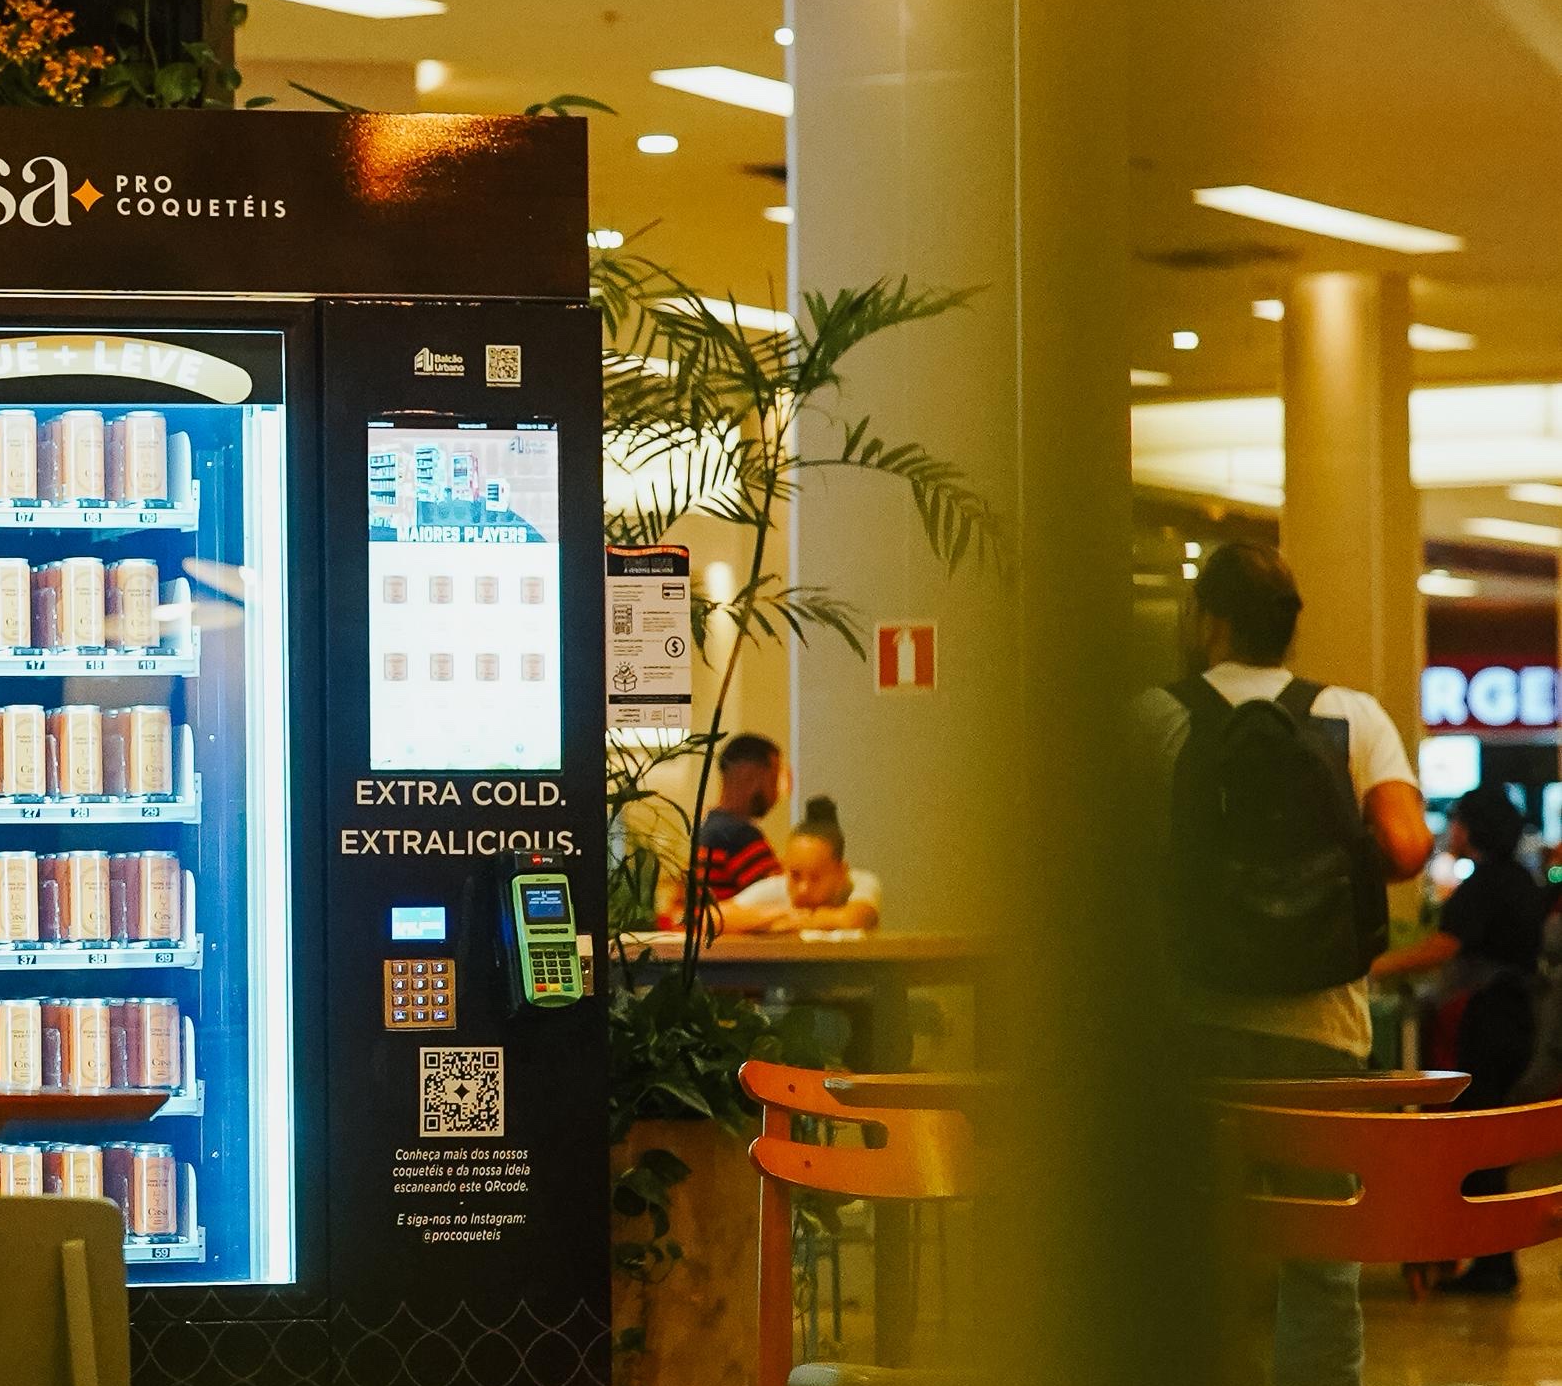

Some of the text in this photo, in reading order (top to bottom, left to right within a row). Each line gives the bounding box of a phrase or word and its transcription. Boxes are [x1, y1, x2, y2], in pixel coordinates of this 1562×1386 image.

[116, 174, 172, 193] PRO
[116, 195, 286, 218] COQUETÉIS
[94, 340, 203, 387] LEVE
[464, 526, 528, 542] PLAYERS
[27, 660, 43, 670] 17
[140, 660, 155, 670] 19
[357, 780, 566, 806] EXTRA COLD.
[24, 809, 39, 819] 27
[144, 808, 158, 818] 29
[341, 830, 582, 855] EXTRALICIOUS.
[20, 956, 35, 965] 37
[90, 955, 105, 964] 38
[157, 953, 172, 963] 39
[395, 1148, 528, 1162] Conheça mais dos nossos
[392, 1163, 530, 1178] coquetéis e da nossa ideia
[394, 1180, 529, 1192] escaneando este QRcode.
[397, 1213, 526, 1227] E siga-nos no Instagram:
[423, 1230, 501, 1243] @procoqueteis
[154, 1248, 169, 1258] 59
